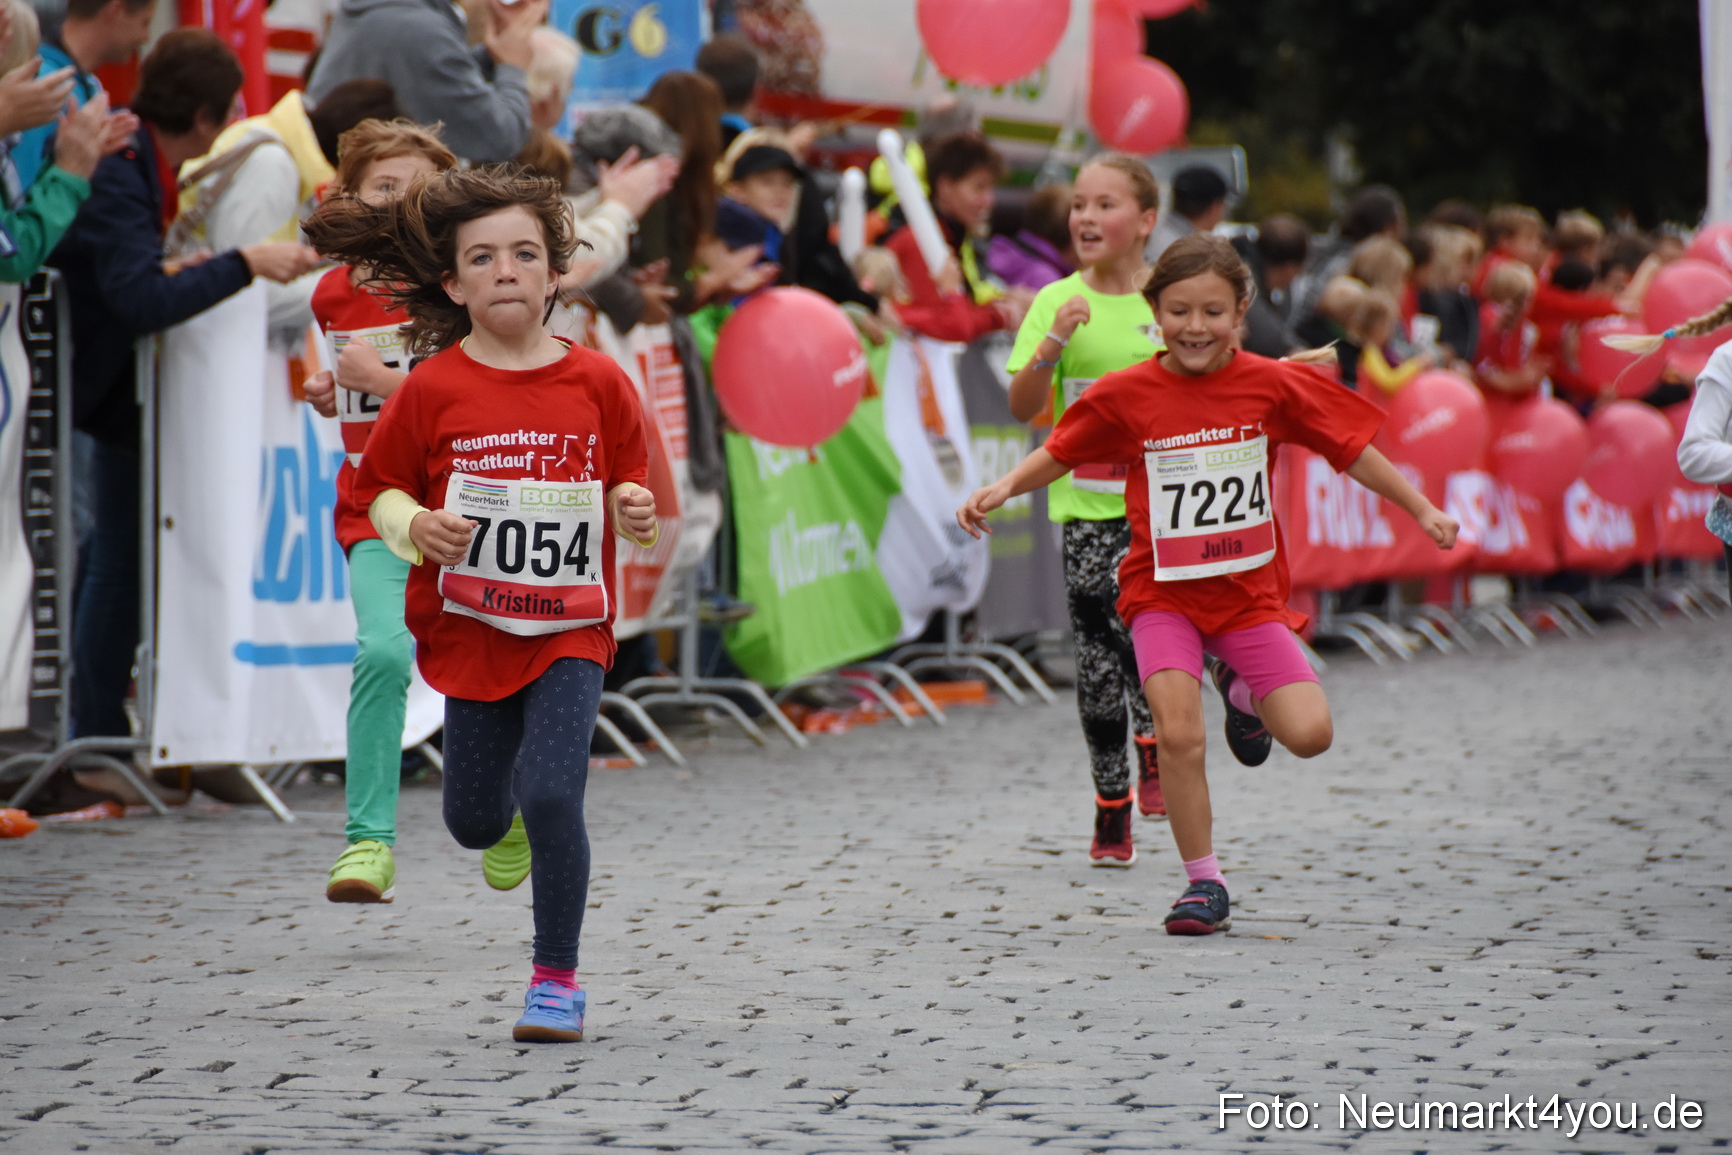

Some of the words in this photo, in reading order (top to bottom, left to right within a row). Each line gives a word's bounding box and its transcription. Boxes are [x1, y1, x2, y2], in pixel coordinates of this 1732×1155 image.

[451, 429, 557, 452] Neumarkter
[1143, 427, 1235, 450] Neumarkter
[452, 451, 535, 472] Stadtlauf
[1205, 443, 1261, 467] BOCK
[1156, 463, 1198, 474] NeuerMarkt
[458, 491, 510, 507] NeuerMarkt
[520, 487, 593, 506] BOCK
[1161, 470, 1266, 530] 7224
[519, 505, 544, 513] inspired
[461, 514, 590, 578] 7054
[1201, 537, 1243, 560] Julia
[590, 572, 597, 582] K
[481, 586, 565, 615] Kristina
